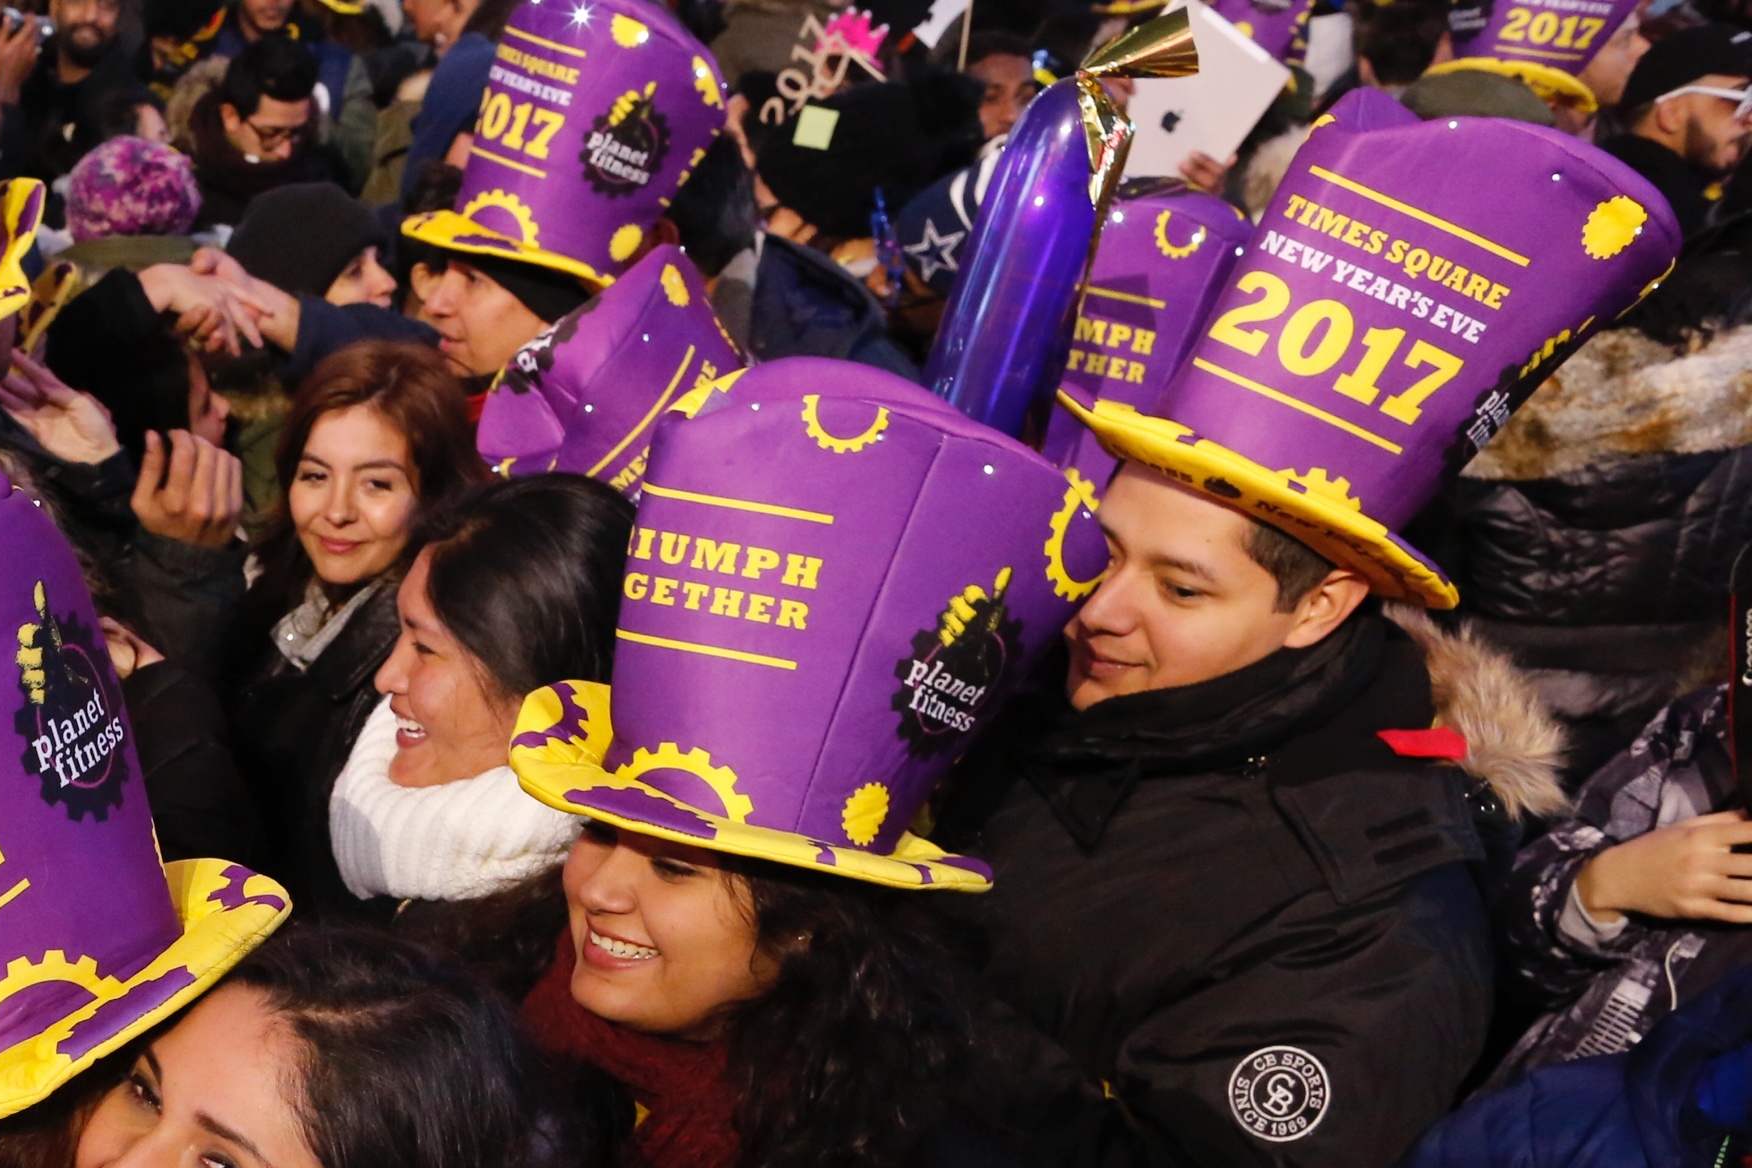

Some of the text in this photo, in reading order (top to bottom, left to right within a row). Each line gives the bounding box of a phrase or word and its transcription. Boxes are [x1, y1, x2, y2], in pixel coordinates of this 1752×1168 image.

[1498, 7, 1606, 51] 2017
[586, 131, 649, 167] planet
[588, 148, 650, 186] fitness
[1282, 194, 1511, 311] TIMES SQUARE
[1259, 230, 1487, 344] NEW YEAR'S EVE
[1207, 270, 1465, 426] 2017
[627, 525, 824, 590] IUMPH
[623, 571, 810, 631] GETHER
[903, 659, 987, 706] planet
[908, 684, 976, 732] fitness
[31, 687, 105, 774] planet
[54, 716, 124, 789] fitness
[1234, 1076, 1308, 1136] SINCE 1969
[1253, 1052, 1325, 1110] CB SPORTS
